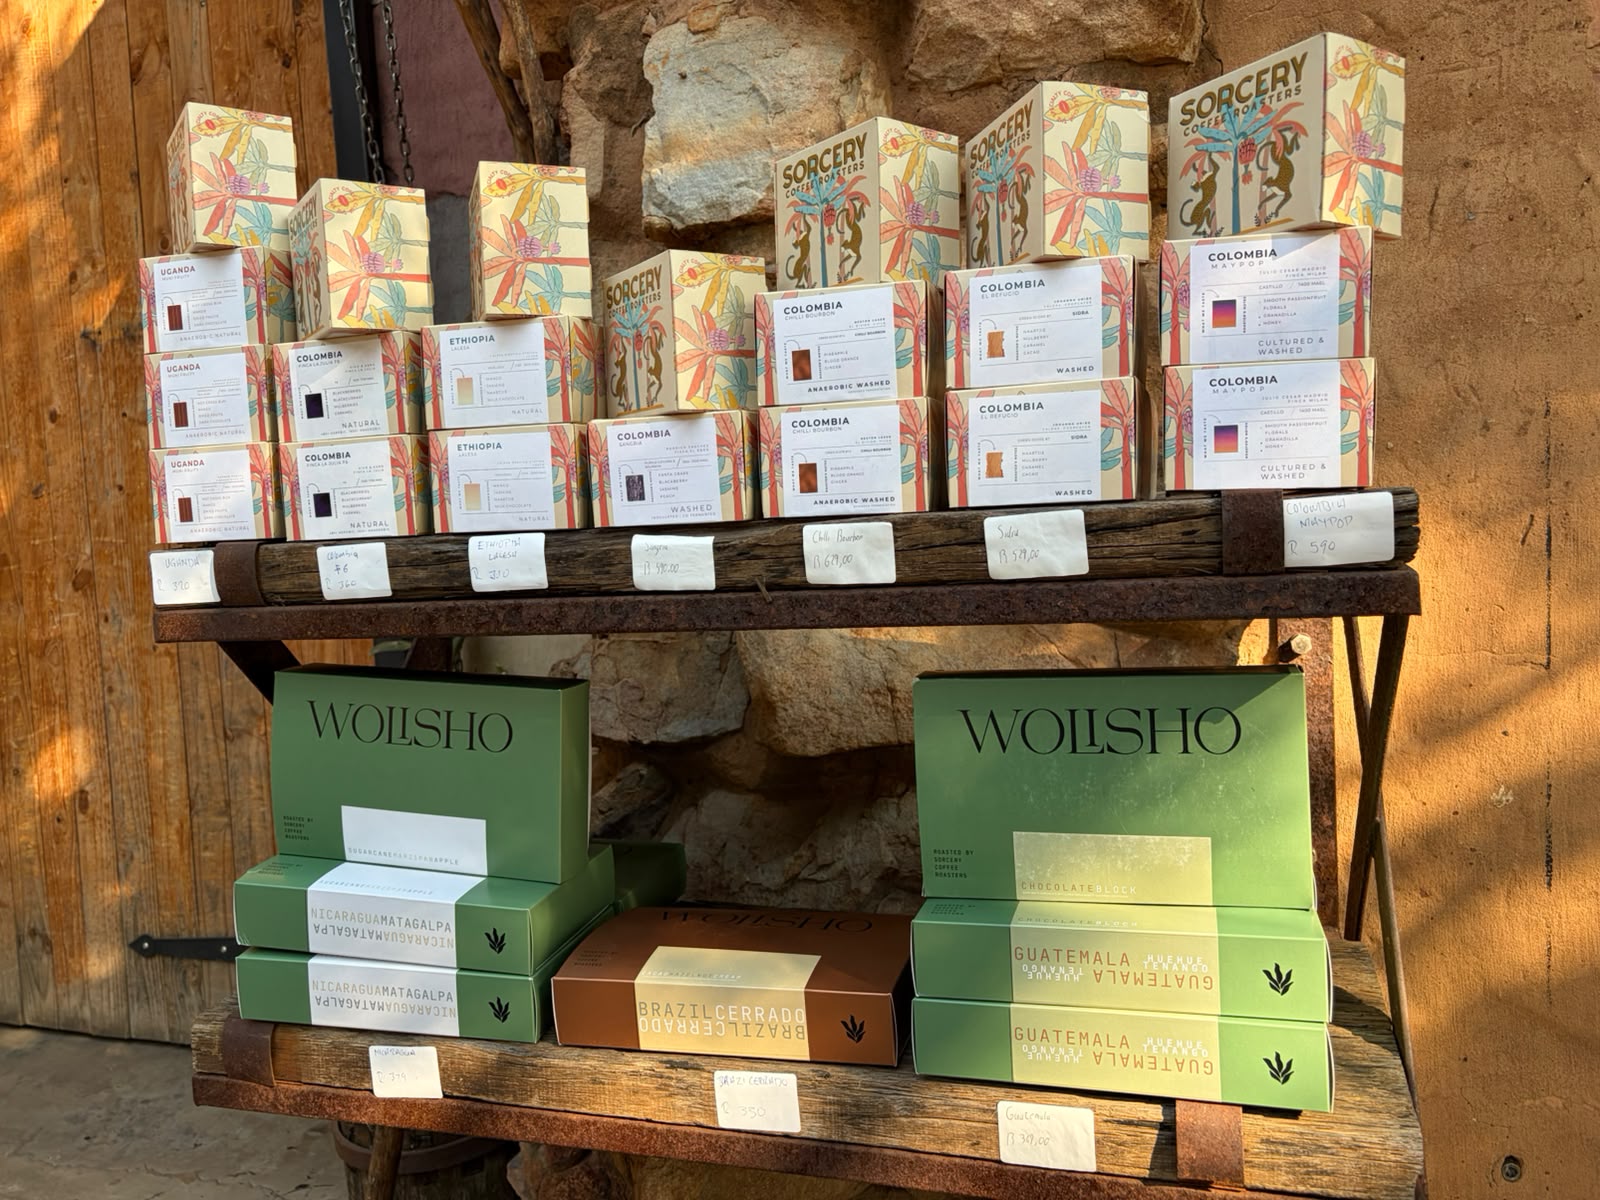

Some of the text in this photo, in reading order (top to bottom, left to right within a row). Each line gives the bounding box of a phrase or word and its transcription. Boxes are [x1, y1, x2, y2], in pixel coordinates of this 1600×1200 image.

[1180, 52, 1308, 126] SORCERY
[1233, 85, 1302, 117] ROASTERS
[970, 99, 1033, 169] SORCERY
[783, 132, 868, 189] SORCERY
[1208, 248, 1278, 262] COLOMBIA
[160, 265, 196, 276] UGANDA
[1211, 260, 1264, 269] MAYPOP
[606, 264, 662, 309] SORCERY
[980, 279, 1046, 294] COLOMBIA
[990, 290, 1020, 298] REFUGIO
[784, 301, 843, 316] COLOMBIA
[784, 310, 836, 320] CHILLI BOURBON
[215, 331, 242, 339] NATURAL
[450, 334, 496, 346] ETHIOPIA
[1258, 337, 1314, 347] CULTURED
[296, 350, 342, 363] COLOMBIA
[1258, 347, 1303, 356] WASHED
[166, 363, 200, 373] UGANDA
[1056, 366, 1094, 374] WASHED
[808, 382, 853, 393] ANAEROBIC
[856, 380, 890, 388] WASHED
[1209, 375, 1278, 387] COLOMBIA
[1212, 386, 1265, 394] MAYPOP
[979, 402, 1044, 414] COLOMBIA
[342, 420, 380, 428] NATURAL
[791, 417, 850, 428] COLOMBIA
[617, 430, 671, 441] COLOMBIA
[457, 442, 502, 452] ETHIOPIA
[305, 452, 351, 462] COLOMBIA
[170, 460, 205, 468] UGANDA
[1260, 464, 1316, 472] CULTURED
[1260, 472, 1305, 480] WASHED
[814, 498, 859, 506] ANAEROBIC
[670, 504, 712, 513] WASHED
[350, 520, 389, 529] NATURAL
[1310, 540, 1336, 554] 590
[164, 556, 200, 568] UGANDA
[814, 555, 821, 568] R
[1014, 946, 1203, 966] GUATEMALA HUEHUE
[1022, 964, 1084, 976] TENANGO
[1142, 960, 1208, 973] TENANGO
[1027, 969, 1214, 990] GUATEMALA HUEHUE
[1014, 1026, 1203, 1050] GUATEMALA HUEHUE
[1022, 1044, 1084, 1057] TENANGO
[1142, 1044, 1208, 1058] TENANGO
[1027, 1052, 1214, 1076] GUATEMALA HUEHUE
[739, 1106, 768, 1120] 350
